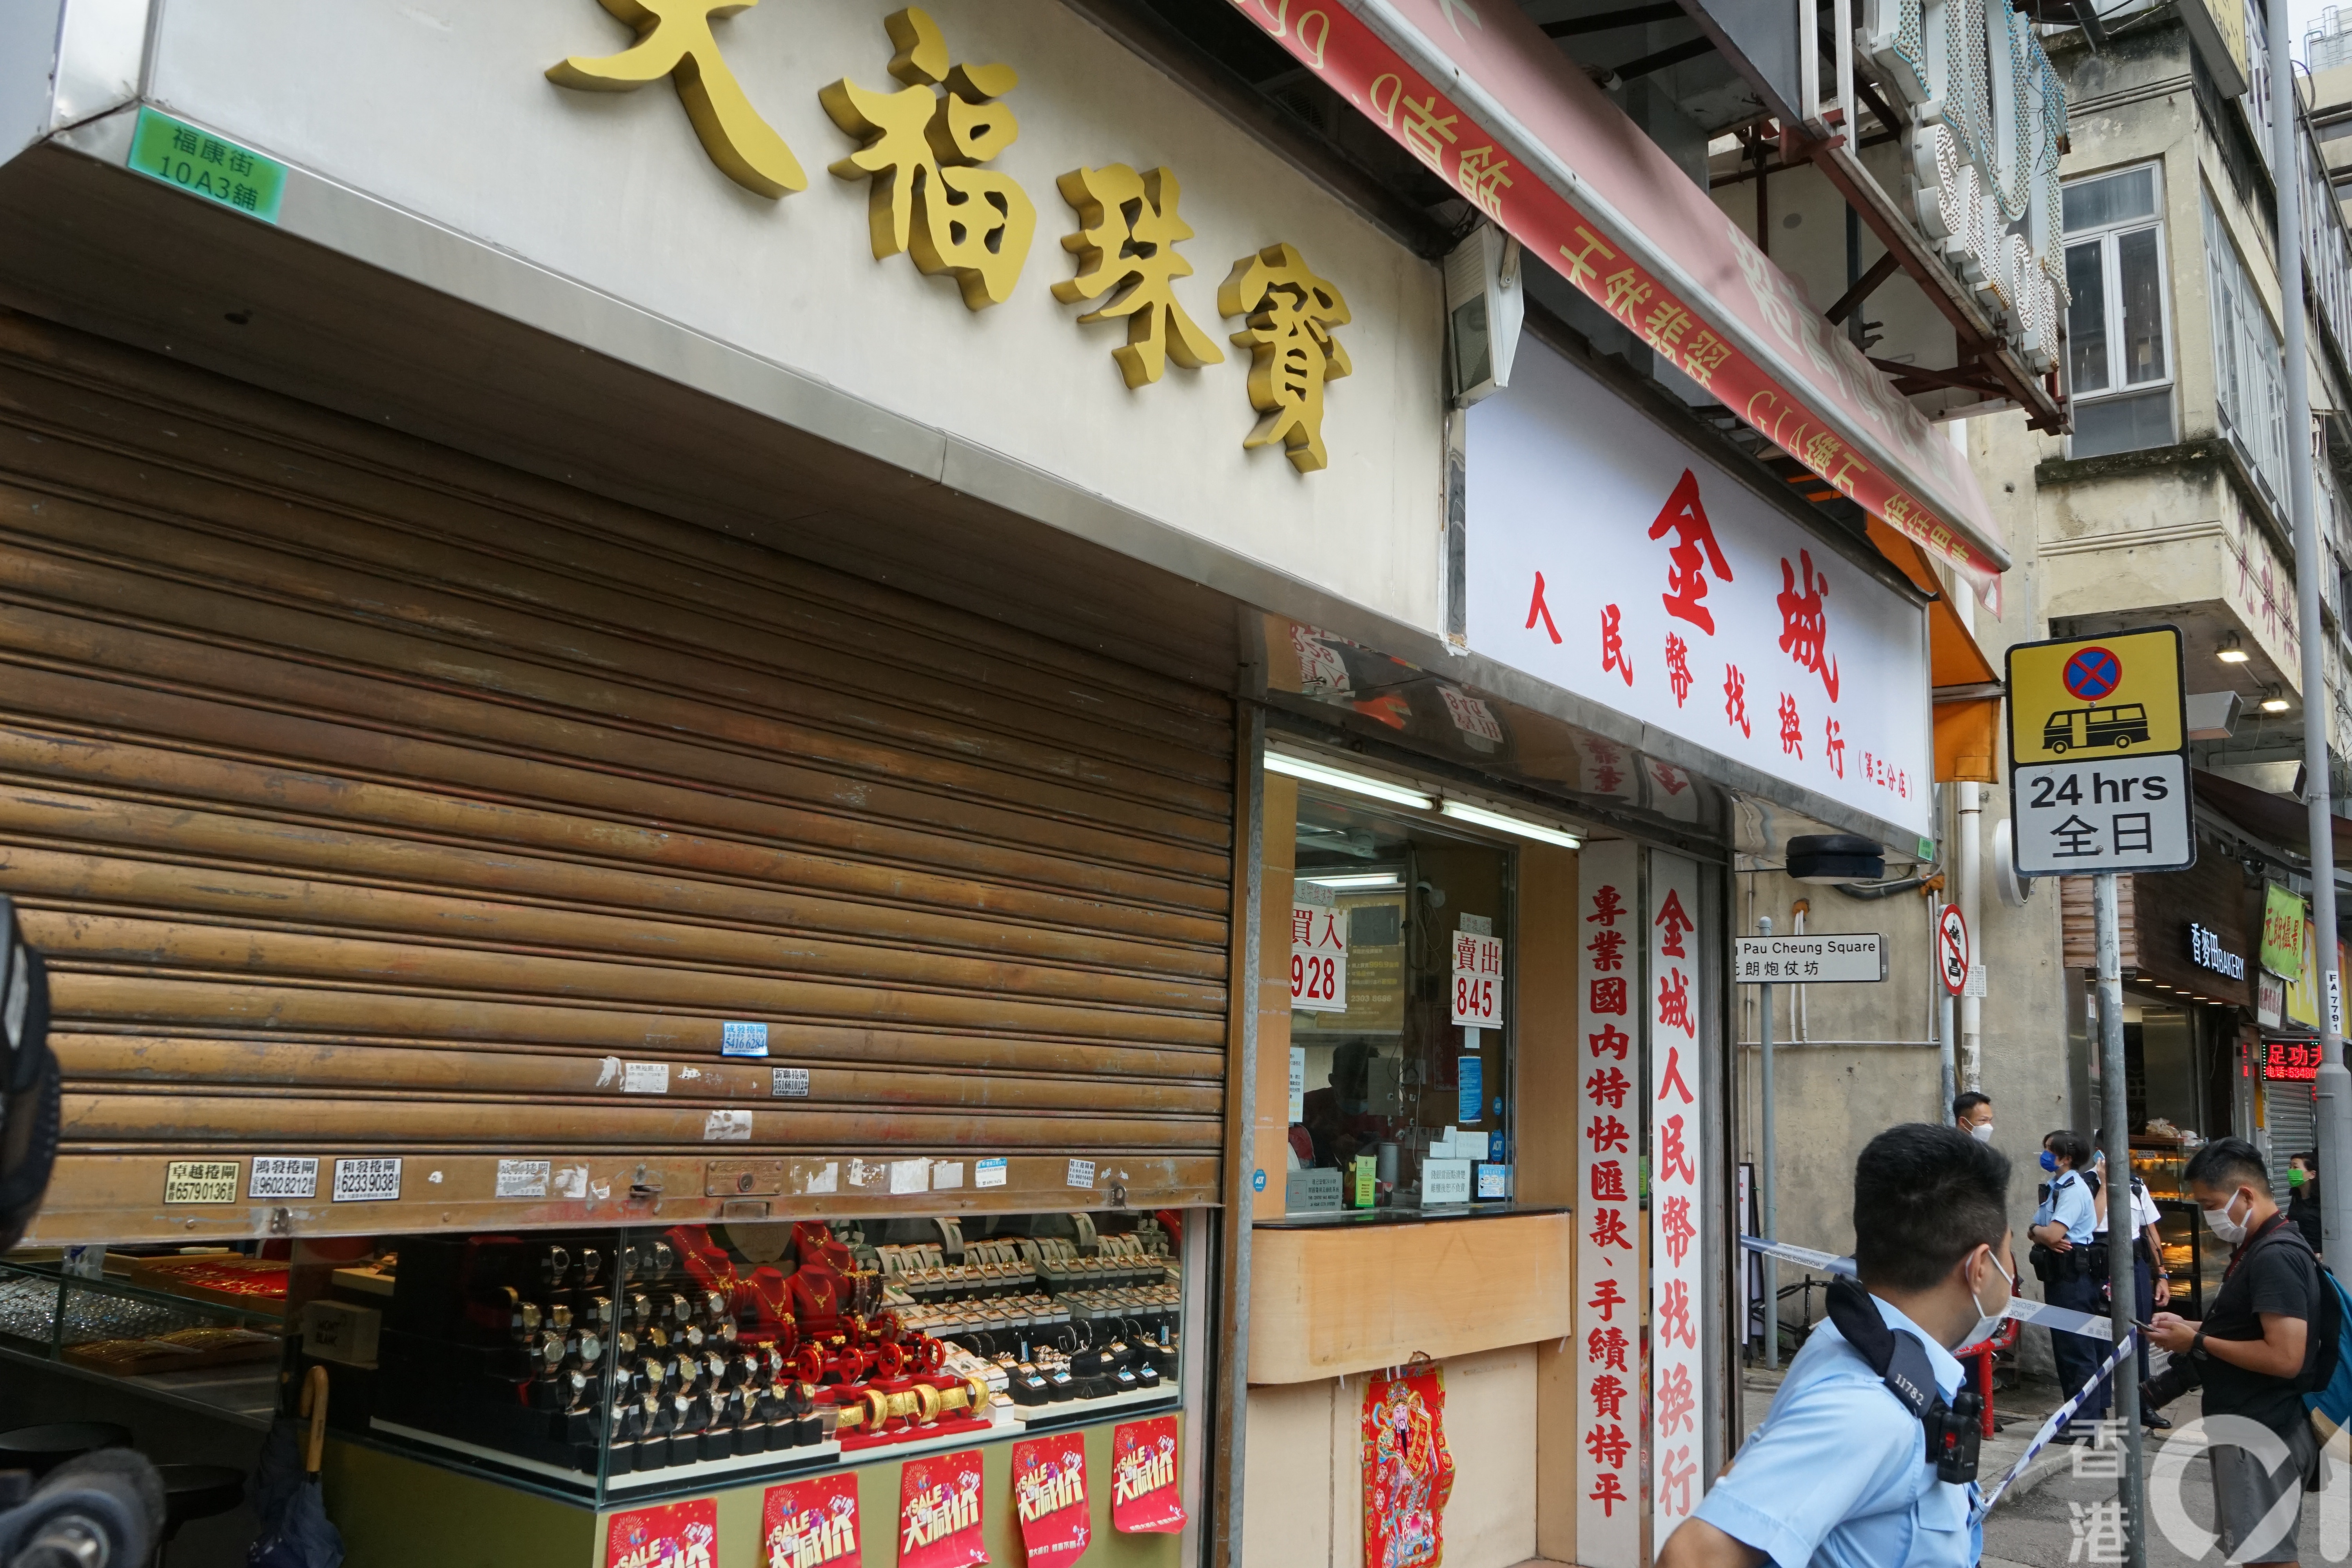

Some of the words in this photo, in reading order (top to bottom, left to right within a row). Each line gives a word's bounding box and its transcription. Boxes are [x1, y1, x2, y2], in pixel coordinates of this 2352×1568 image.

[1234, 0, 1513, 226] 99.9首飾
[174, 125, 253, 177] 福康街
[1917, 123, 2059, 371] SALON
[1560, 226, 1732, 388] 天然翡翠
[1649, 468, 1838, 703] 金城
[1525, 571, 1846, 780] 人民幣找換行
[2031, 774, 2083, 808] 24
[2093, 772, 2168, 804] hrs
[2050, 813, 2152, 858] 全日
[1292, 910, 1343, 950] 買入
[1744, 943, 1767, 954] Pau
[1772, 942, 1822, 955] Cheung
[1828, 941, 1875, 954] Square
[1456, 936, 1499, 975] 賣出
[2191, 923, 2218, 975] 香麥田
[2218, 947, 2244, 981] BAKERY
[1291, 954, 1334, 1000] 928
[1457, 977, 1492, 1018] 845
[1492, 1141, 1502, 1151] ADT
[176, 1182, 200, 1200] 6579
[203, 1182, 227, 1200] 0136
[342, 1174, 367, 1192] 6233
[369, 1173, 393, 1191] 9038
[1655, 889, 1697, 1517] 金城人民幣找換行
[1895, 1374, 1924, 1406] 11782
[1021, 1462, 1047, 1490] SALE
[1121, 1445, 1145, 1471] SALE
[911, 1483, 942, 1514] SALE
[774, 1510, 809, 1540] SALE
[620, 1537, 661, 1568] SALE
